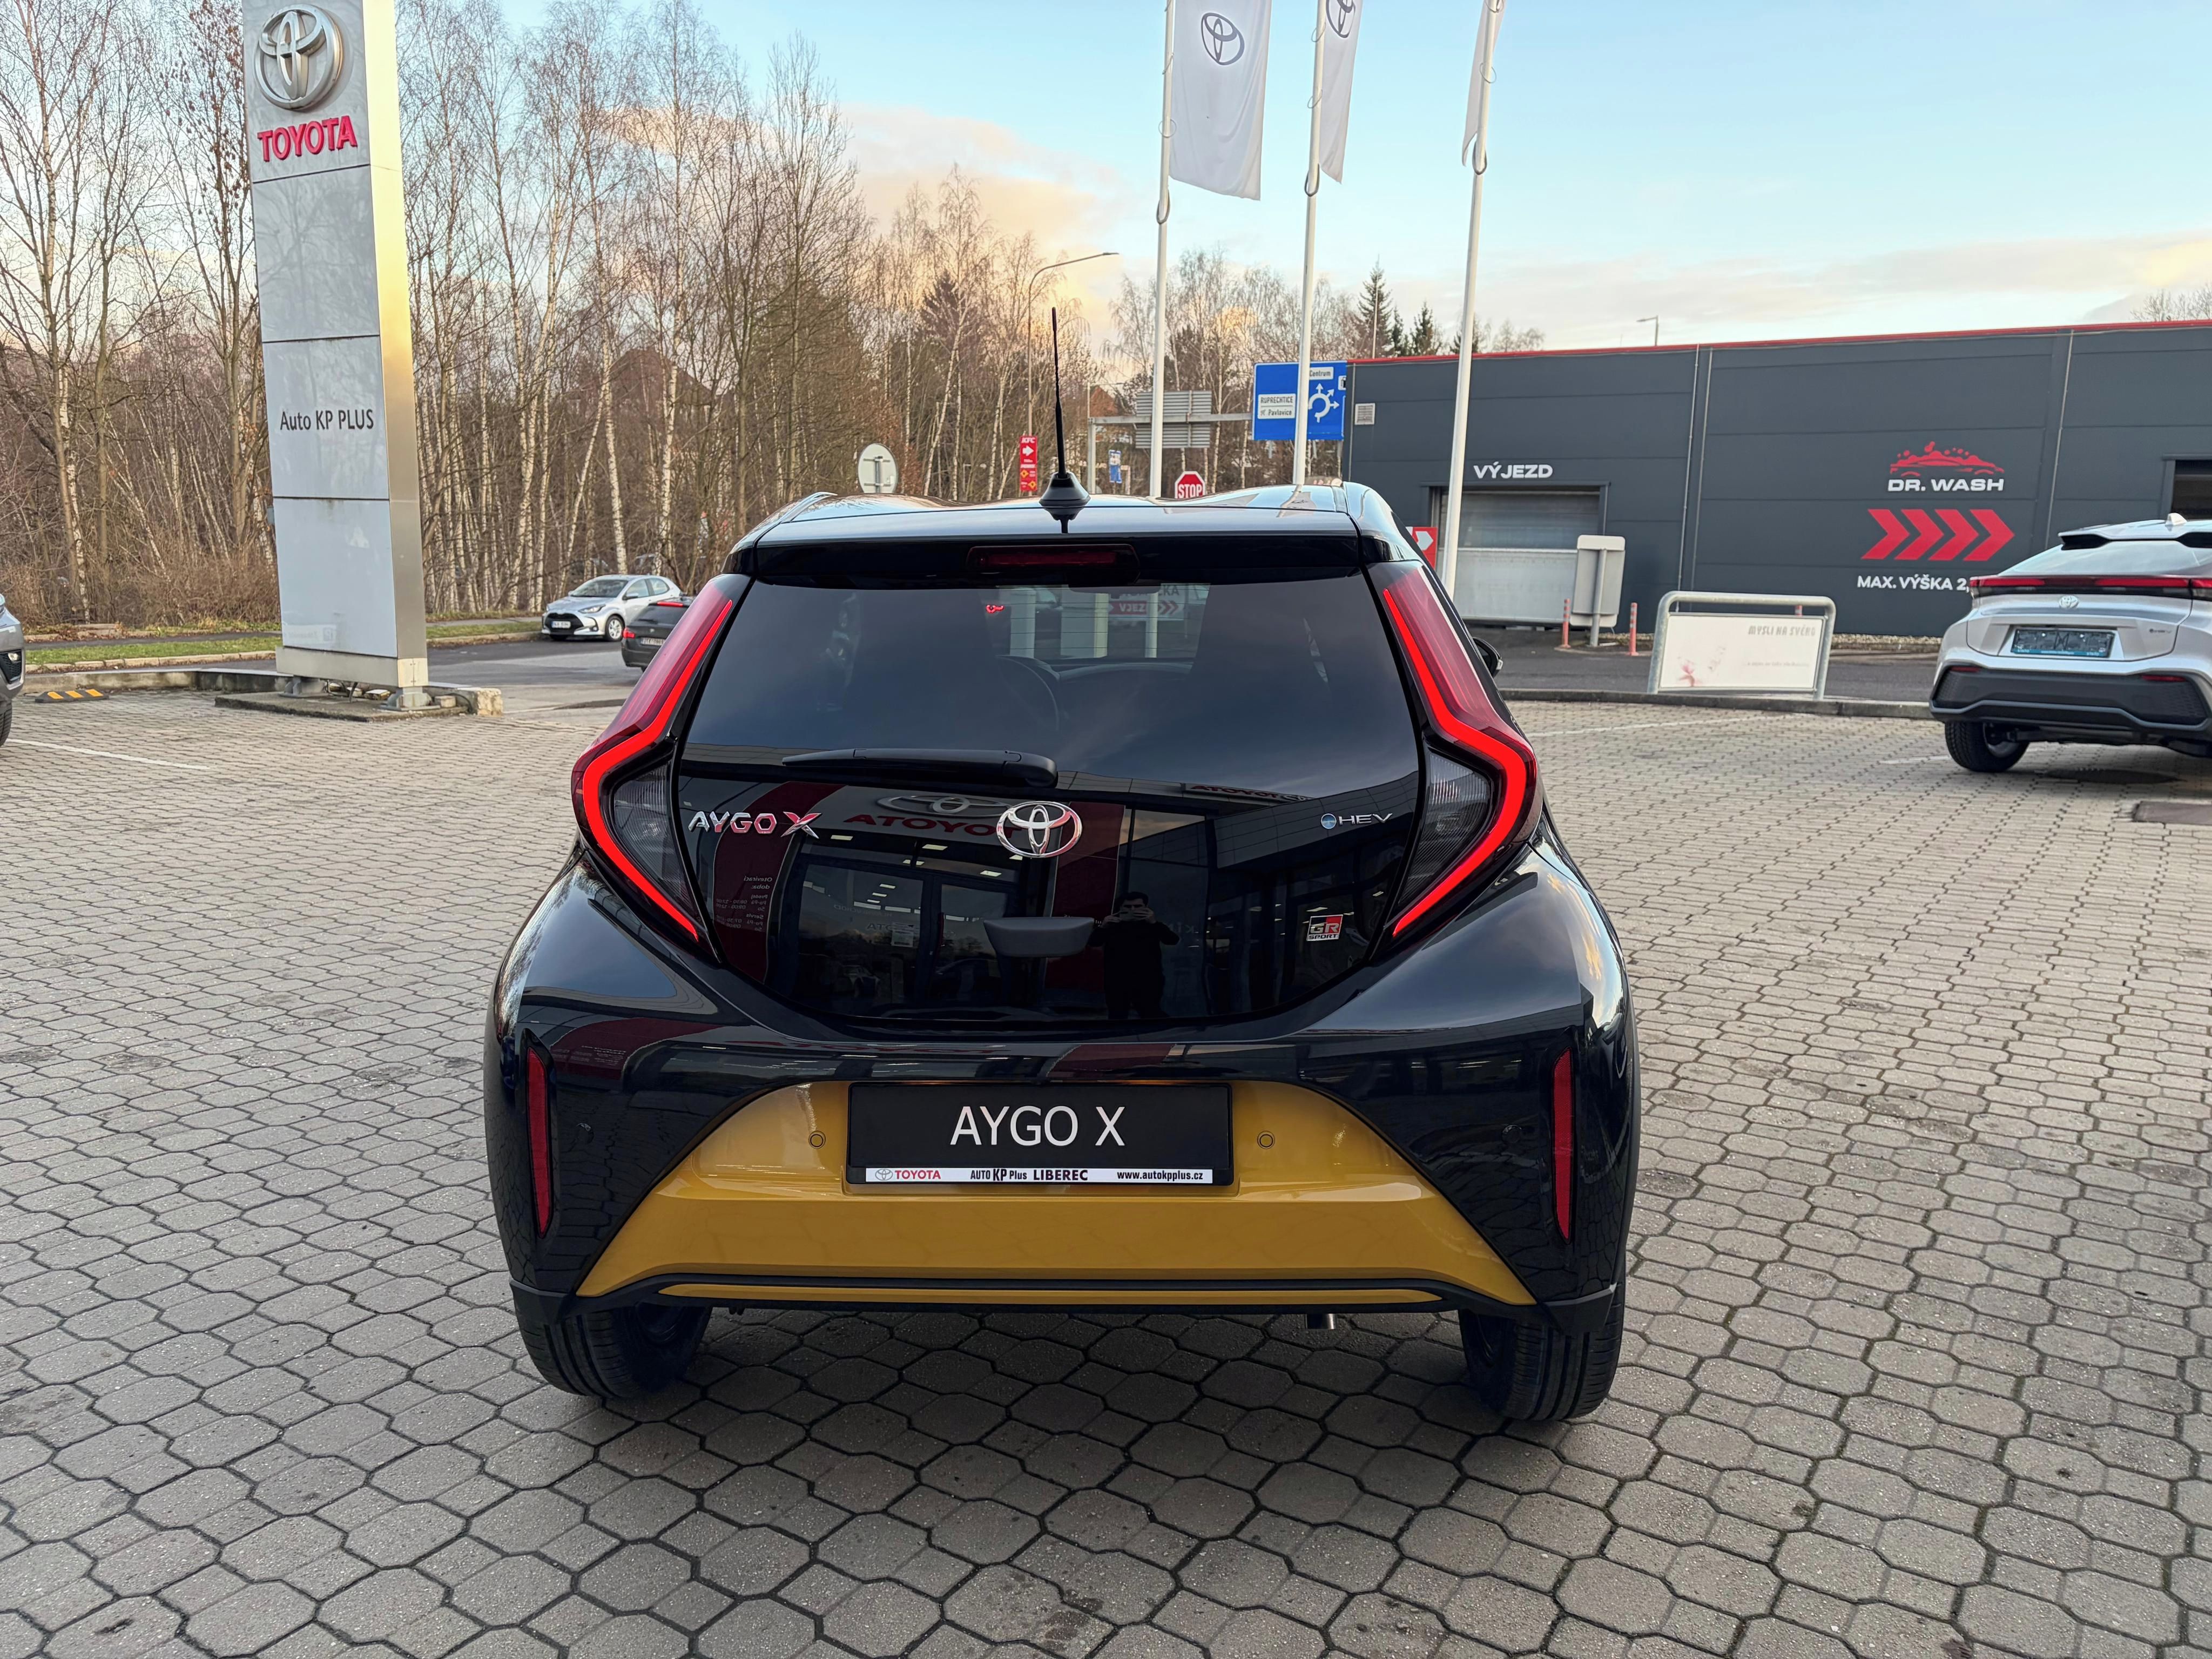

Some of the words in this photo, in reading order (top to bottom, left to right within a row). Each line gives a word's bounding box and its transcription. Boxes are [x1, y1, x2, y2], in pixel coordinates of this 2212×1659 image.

[257, 115, 358, 162] TOYOTA
[280, 411, 311, 430] Auto
[316, 410, 333, 430] KP
[339, 409, 374, 429] PLUS
[1473, 461, 1553, 479] VÝJEZD
[1178, 483, 1202, 498] STOP
[1887, 478, 1926, 491] DR.
[1931, 478, 2004, 491] WASH
[1857, 575, 1897, 589] MAX.
[1899, 574, 1953, 590] VÝŠKA
[1748, 625, 1774, 635] MYSLI
[1776, 626, 1788, 636] NA
[688, 811, 778, 834] AYGO
[780, 811, 822, 839] X
[1339, 813, 1393, 825] HEV
[1310, 922, 1340, 934] GR
[949, 1105, 1078, 1147] AYGO
[1095, 1106, 1125, 1147] X
[895, 1170, 941, 1179] TOYOTA
[970, 1170, 990, 1179] AUTO
[993, 1169, 1007, 1181] KP
[1009, 1170, 1027, 1179] Plus
[1034, 1169, 1088, 1181] LIBEREC
[1117, 1170, 1203, 1182] www.autokpplus.cz
